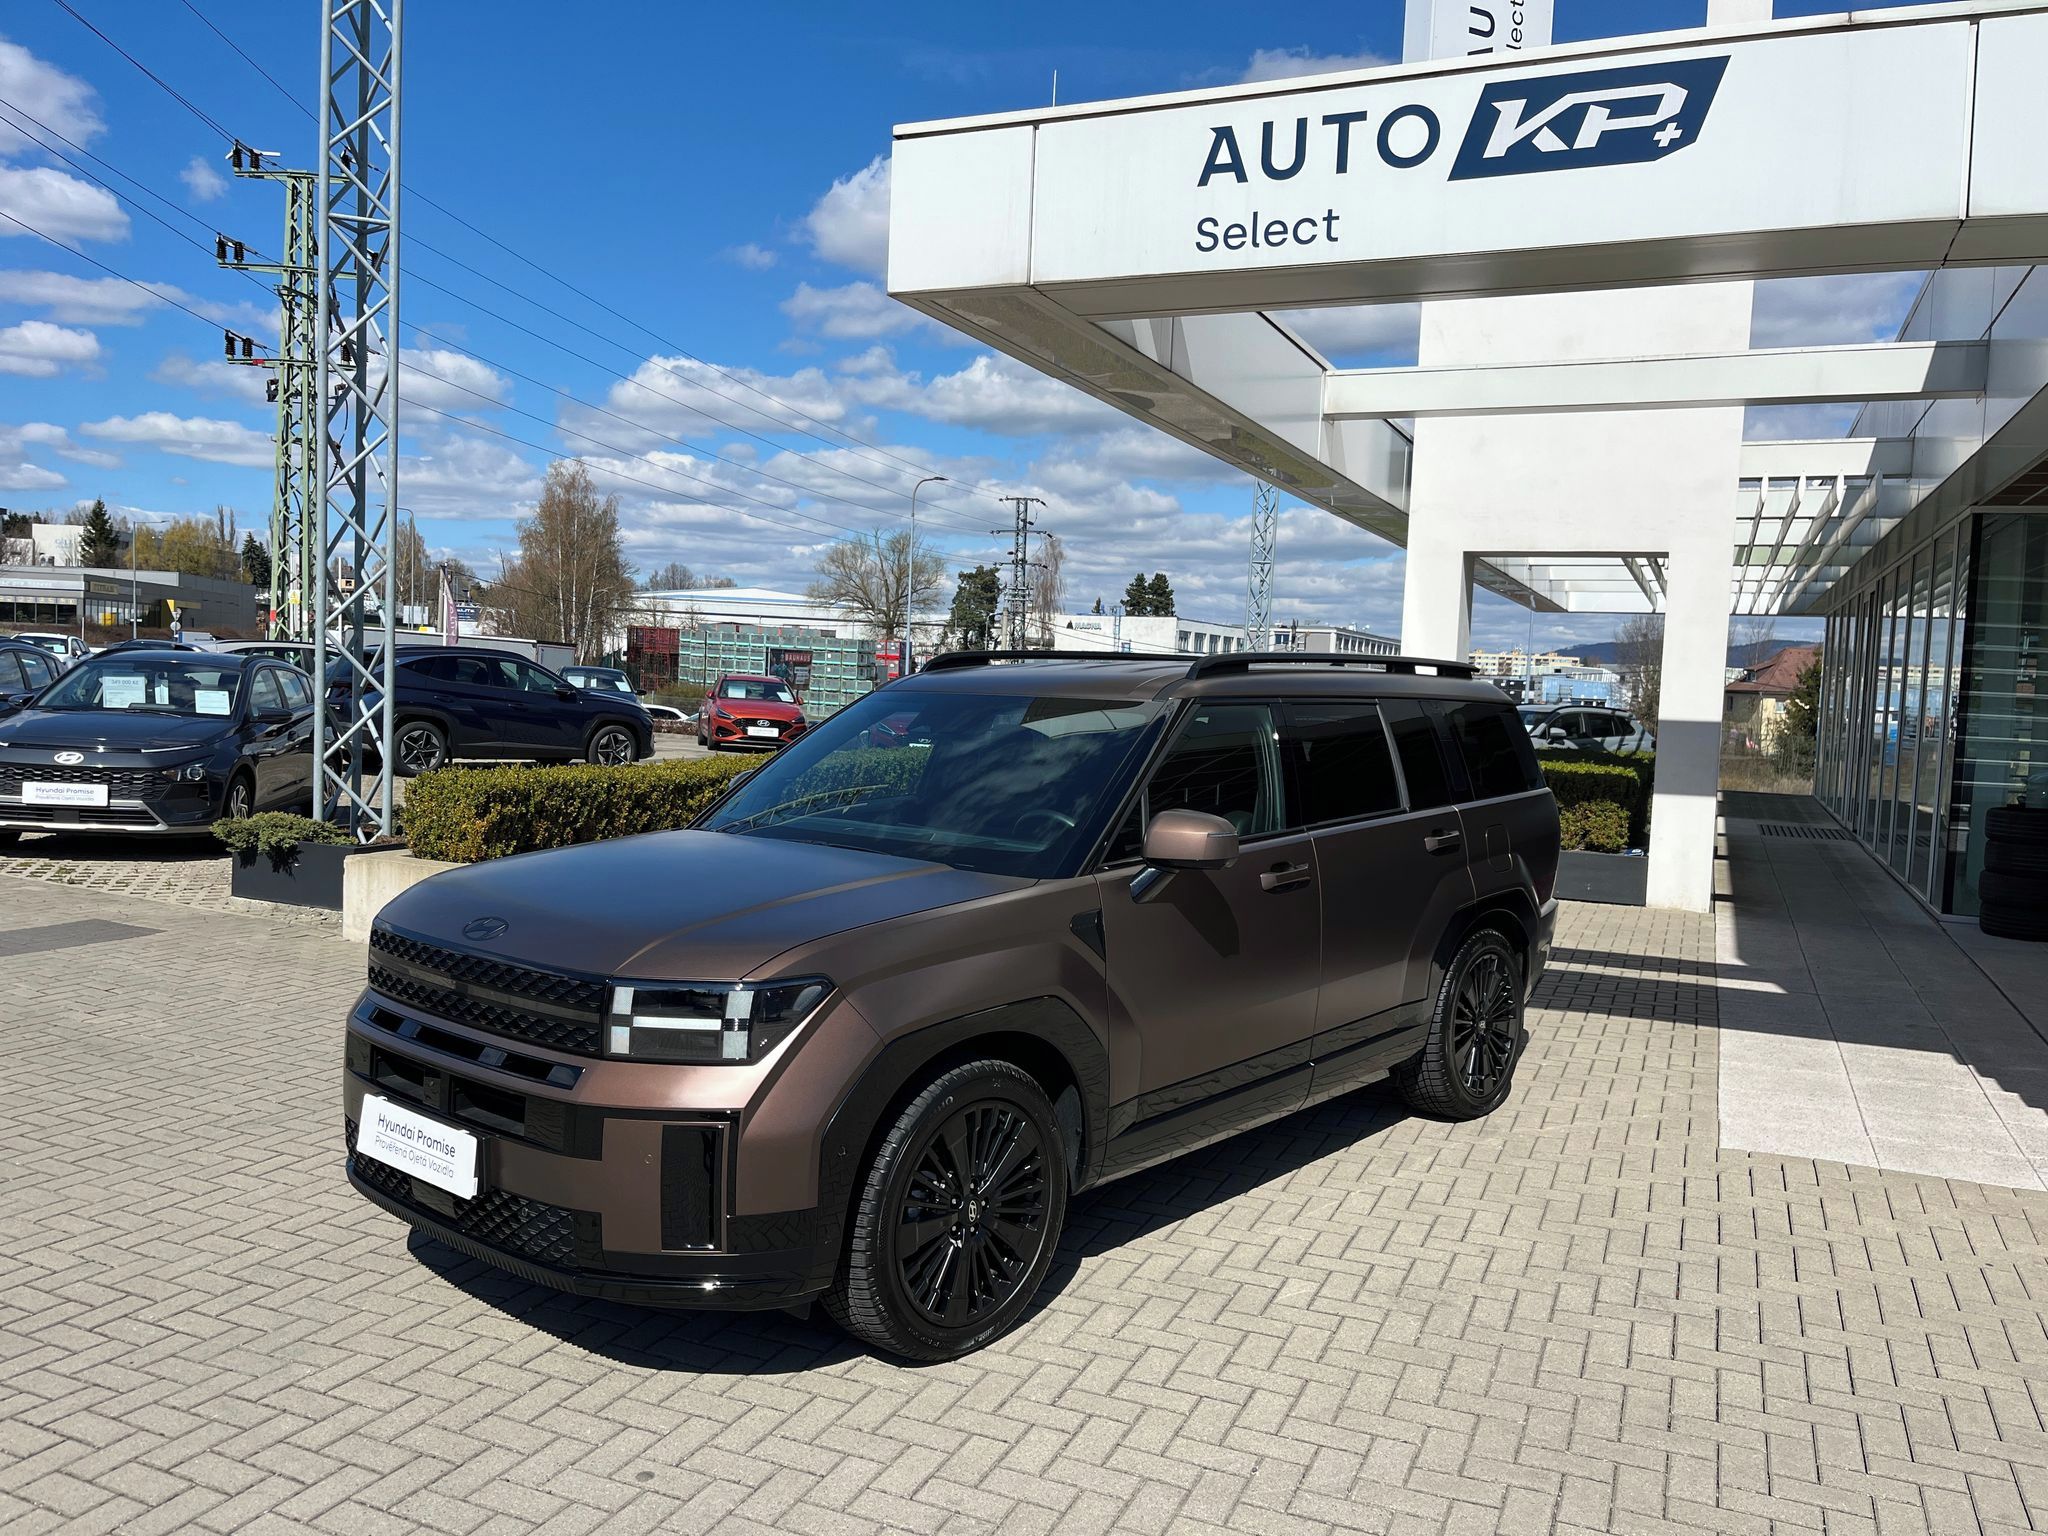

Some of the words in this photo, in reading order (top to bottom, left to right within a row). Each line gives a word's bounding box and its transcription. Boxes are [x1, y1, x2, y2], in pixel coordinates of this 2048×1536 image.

[1197, 104, 1441, 187] AUTO
[1195, 209, 1340, 252] Select
[785, 653, 811, 662] BAUHAUS
[35, 787, 65, 796] Hyundai
[66, 787, 94, 795] Promise
[375, 1135, 408, 1159] Prověřená
[408, 1150, 427, 1167] Ojetá
[428, 1158, 454, 1178] Vozidla
[378, 1113, 416, 1142] Hyundai
[417, 1130, 456, 1158] Promise
